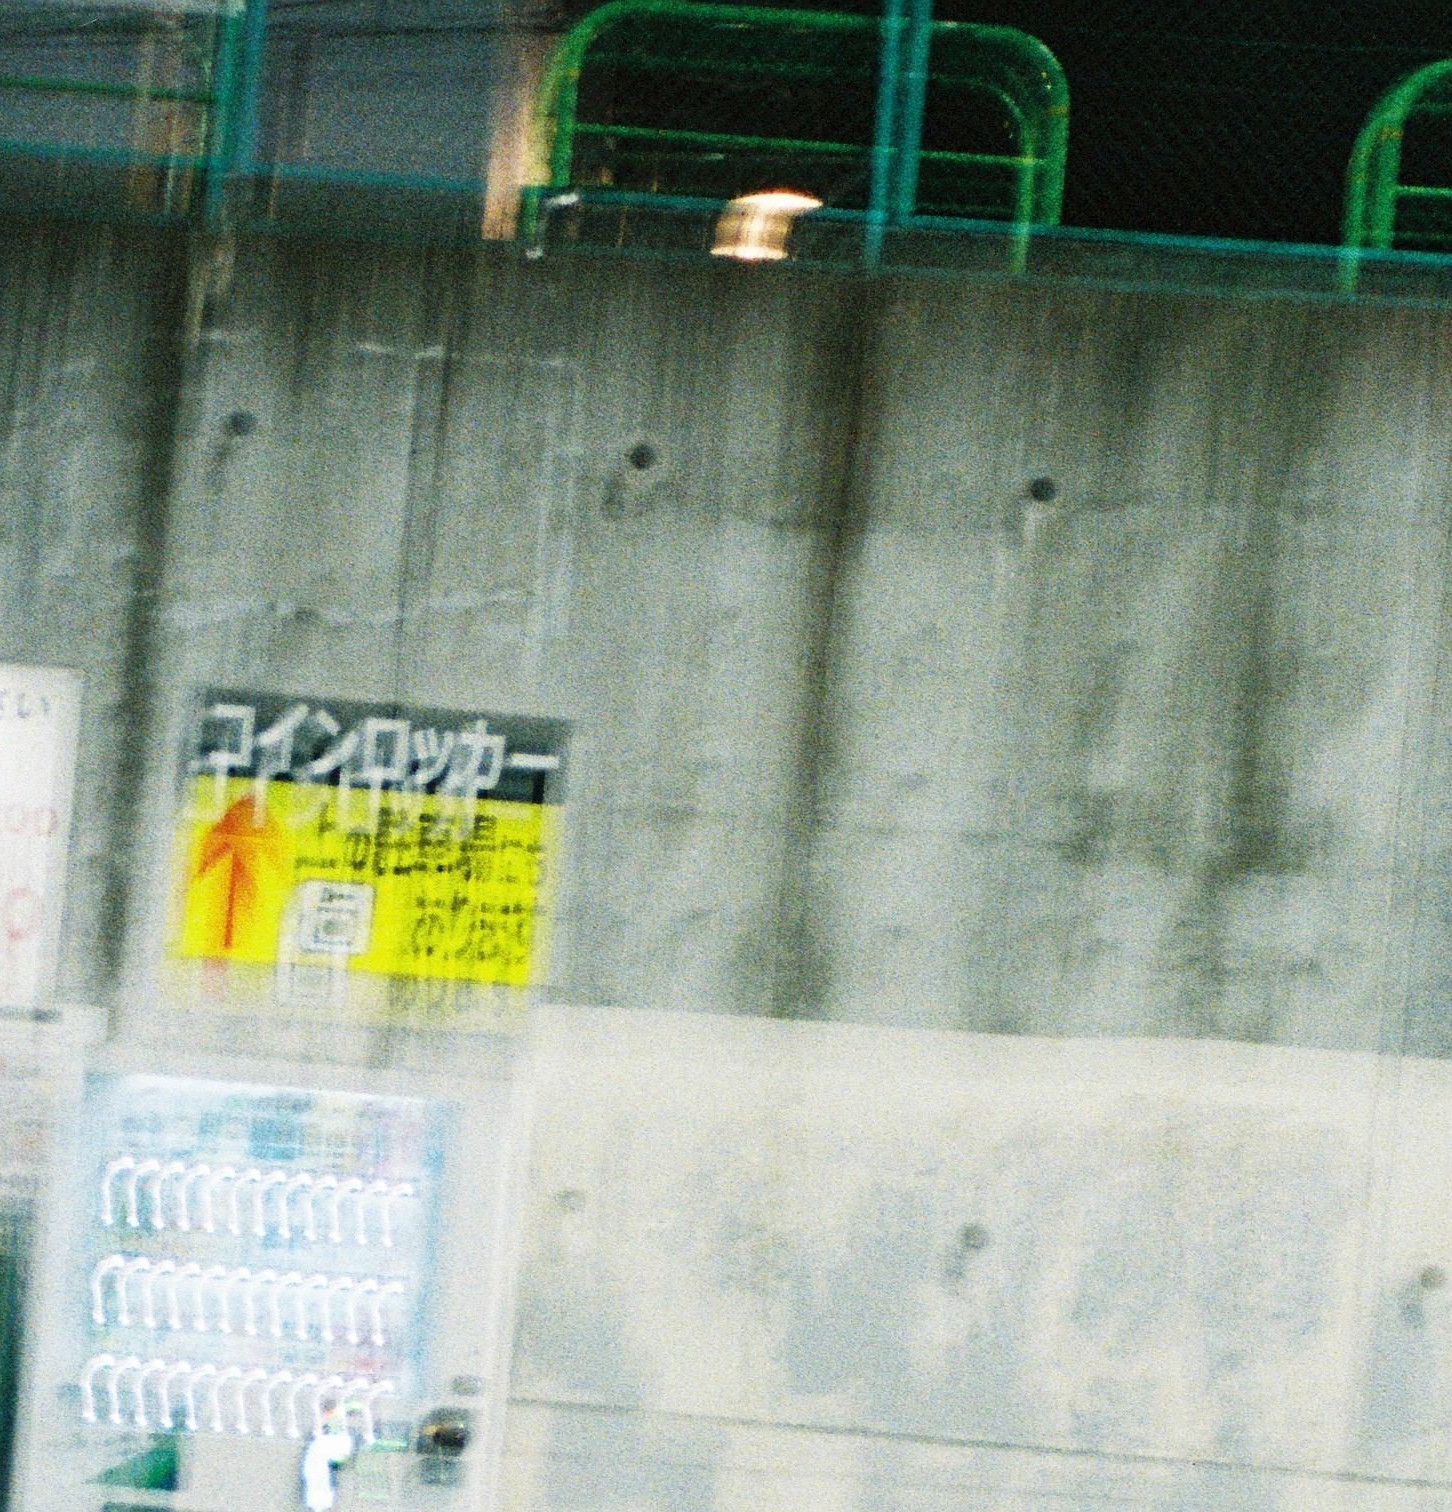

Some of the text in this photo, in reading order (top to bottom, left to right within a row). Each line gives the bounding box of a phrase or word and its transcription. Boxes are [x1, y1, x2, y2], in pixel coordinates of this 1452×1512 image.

[207, 702, 561, 792] コインロッカー
